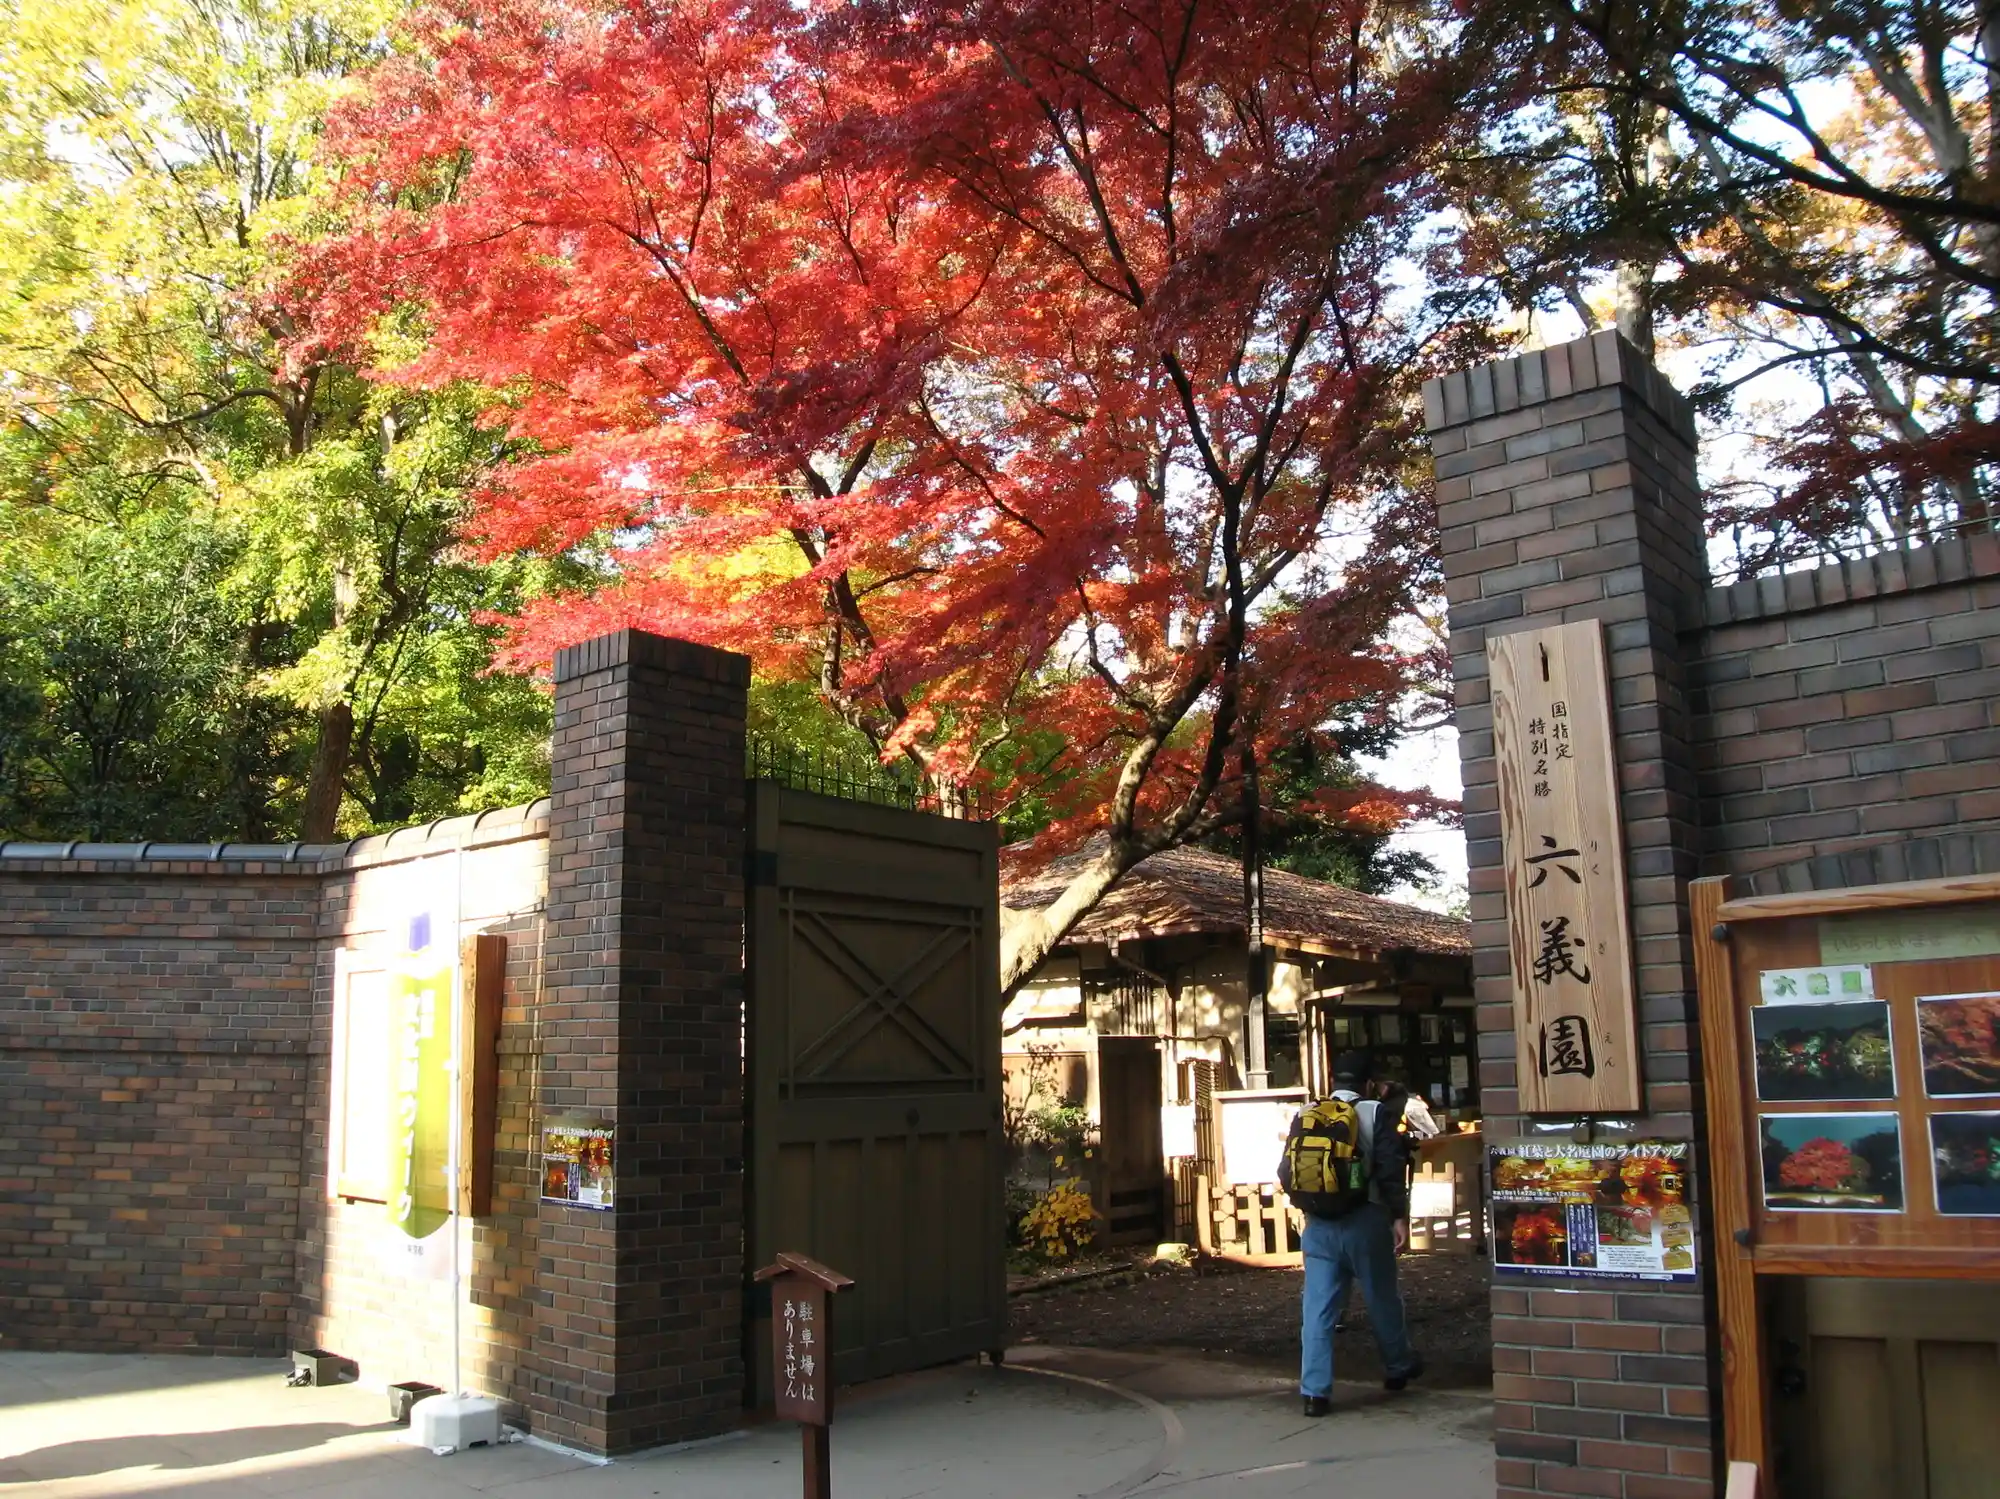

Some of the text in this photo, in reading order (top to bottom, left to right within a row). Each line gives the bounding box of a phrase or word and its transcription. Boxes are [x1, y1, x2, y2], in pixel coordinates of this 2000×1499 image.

[1527, 718, 1552, 798] 特別名勝
[1551, 701, 1574, 760] 国指定
[1524, 834, 1596, 1080] 六義園
[783, 1299, 797, 1399] ありません
[798, 1301, 816, 1402] 駐車場は
